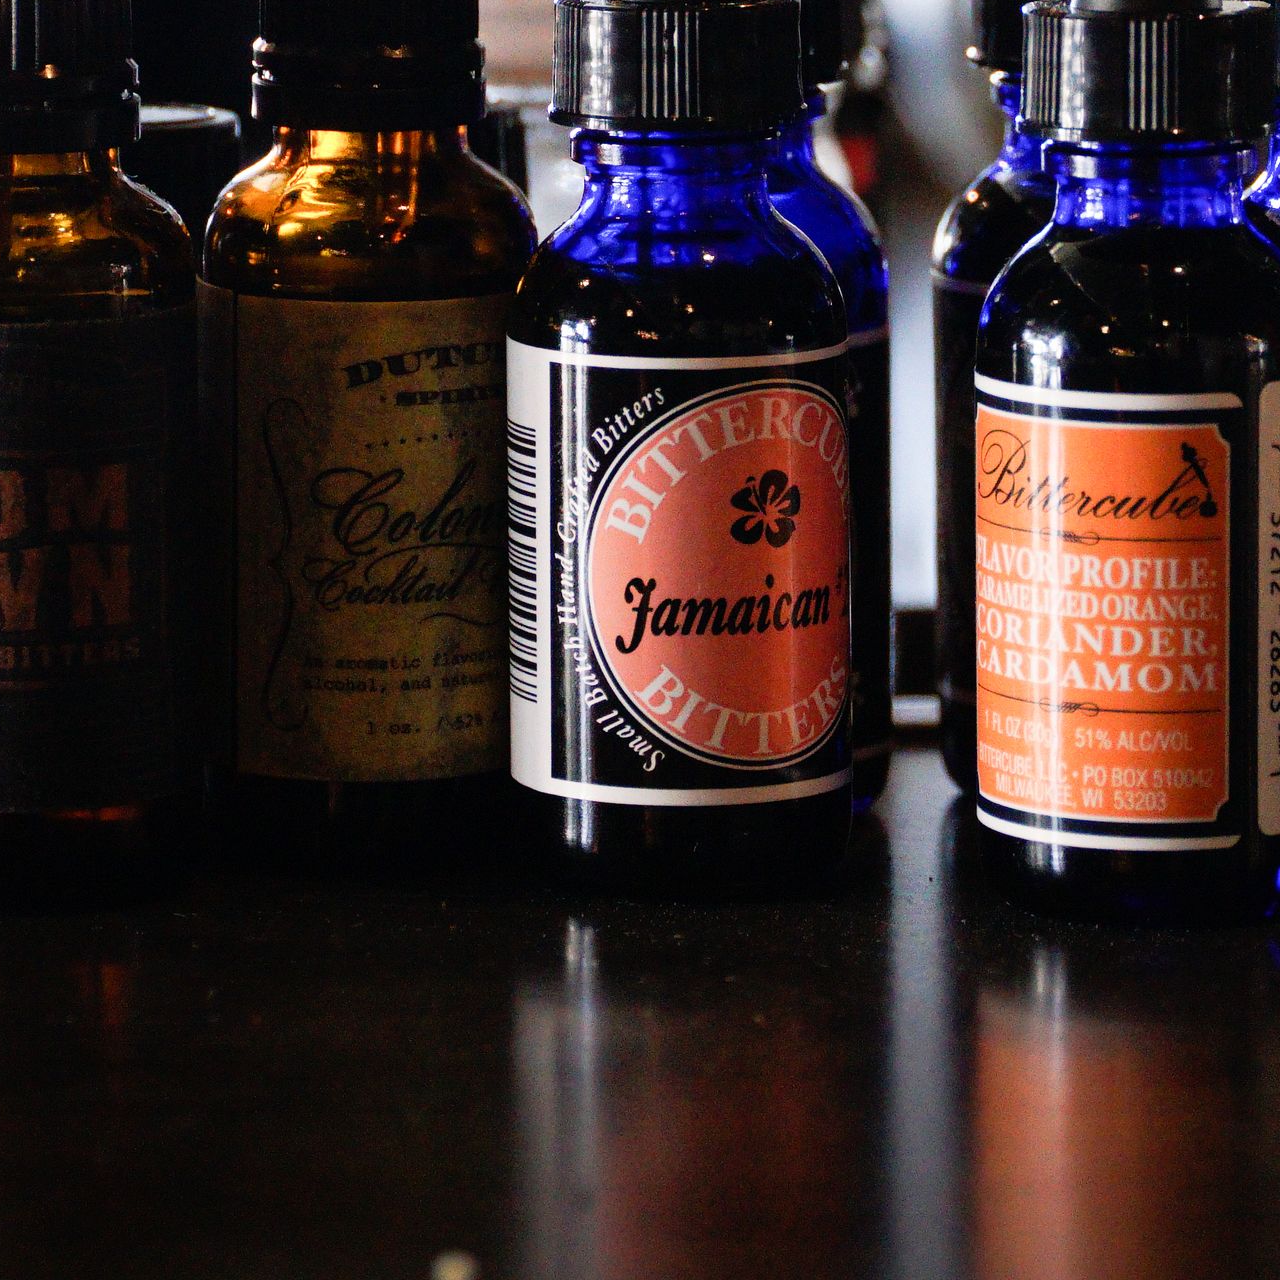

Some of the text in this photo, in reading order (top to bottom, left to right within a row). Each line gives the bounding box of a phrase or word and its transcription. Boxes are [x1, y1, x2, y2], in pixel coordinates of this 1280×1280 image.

[591, 386, 666, 457] Bitters
[977, 428, 1202, 521] Bittercube
[300, 549, 480, 613] Cocktail
[976, 534, 1058, 581] FLAVOR
[614, 573, 831, 656] Jamaican
[976, 572, 1099, 620] CARAMELIZED
[563, 634, 609, 710] Batch
[976, 640, 1219, 694] CARDAMOM
[633, 654, 850, 757] BITTERS
[1005, 715, 1022, 739] OZ
[1074, 726, 1112, 751] 51%
[1116, 729, 1194, 753] ALC/VOL
[596, 706, 666, 774] Small
[1081, 788, 1105, 809] WI
[1113, 790, 1168, 812] 53203
[1082, 765, 1108, 787] PO
[1111, 767, 1148, 789] BOX
